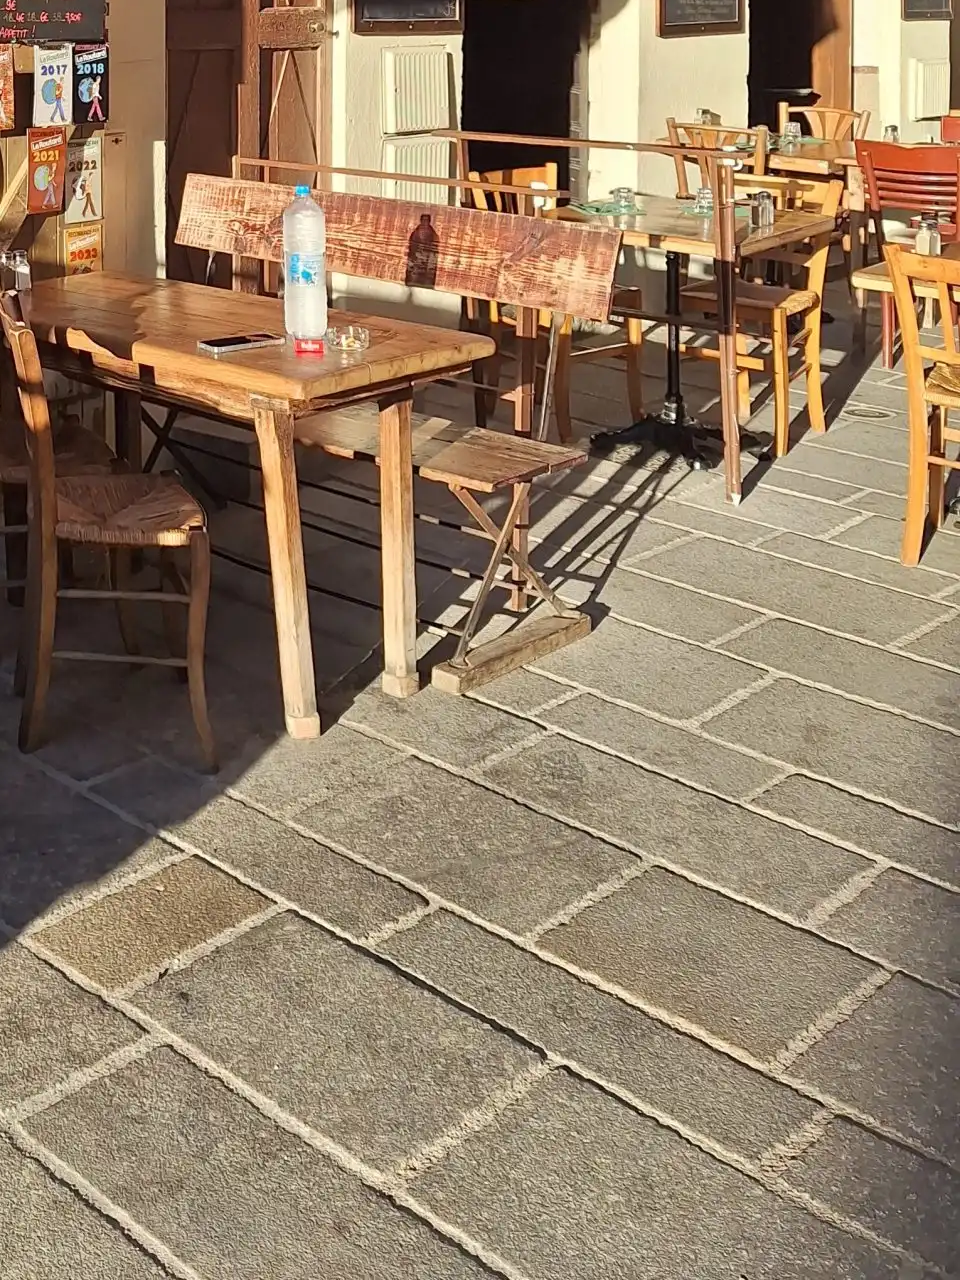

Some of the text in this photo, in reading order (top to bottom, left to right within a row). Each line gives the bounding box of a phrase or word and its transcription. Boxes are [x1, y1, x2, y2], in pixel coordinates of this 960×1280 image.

[41, 64, 68, 77] 2017
[76, 63, 105, 76] 2018
[32, 150, 59, 162] 2021
[68, 160, 98, 173] 2022
[69, 249, 98, 262] 2023
